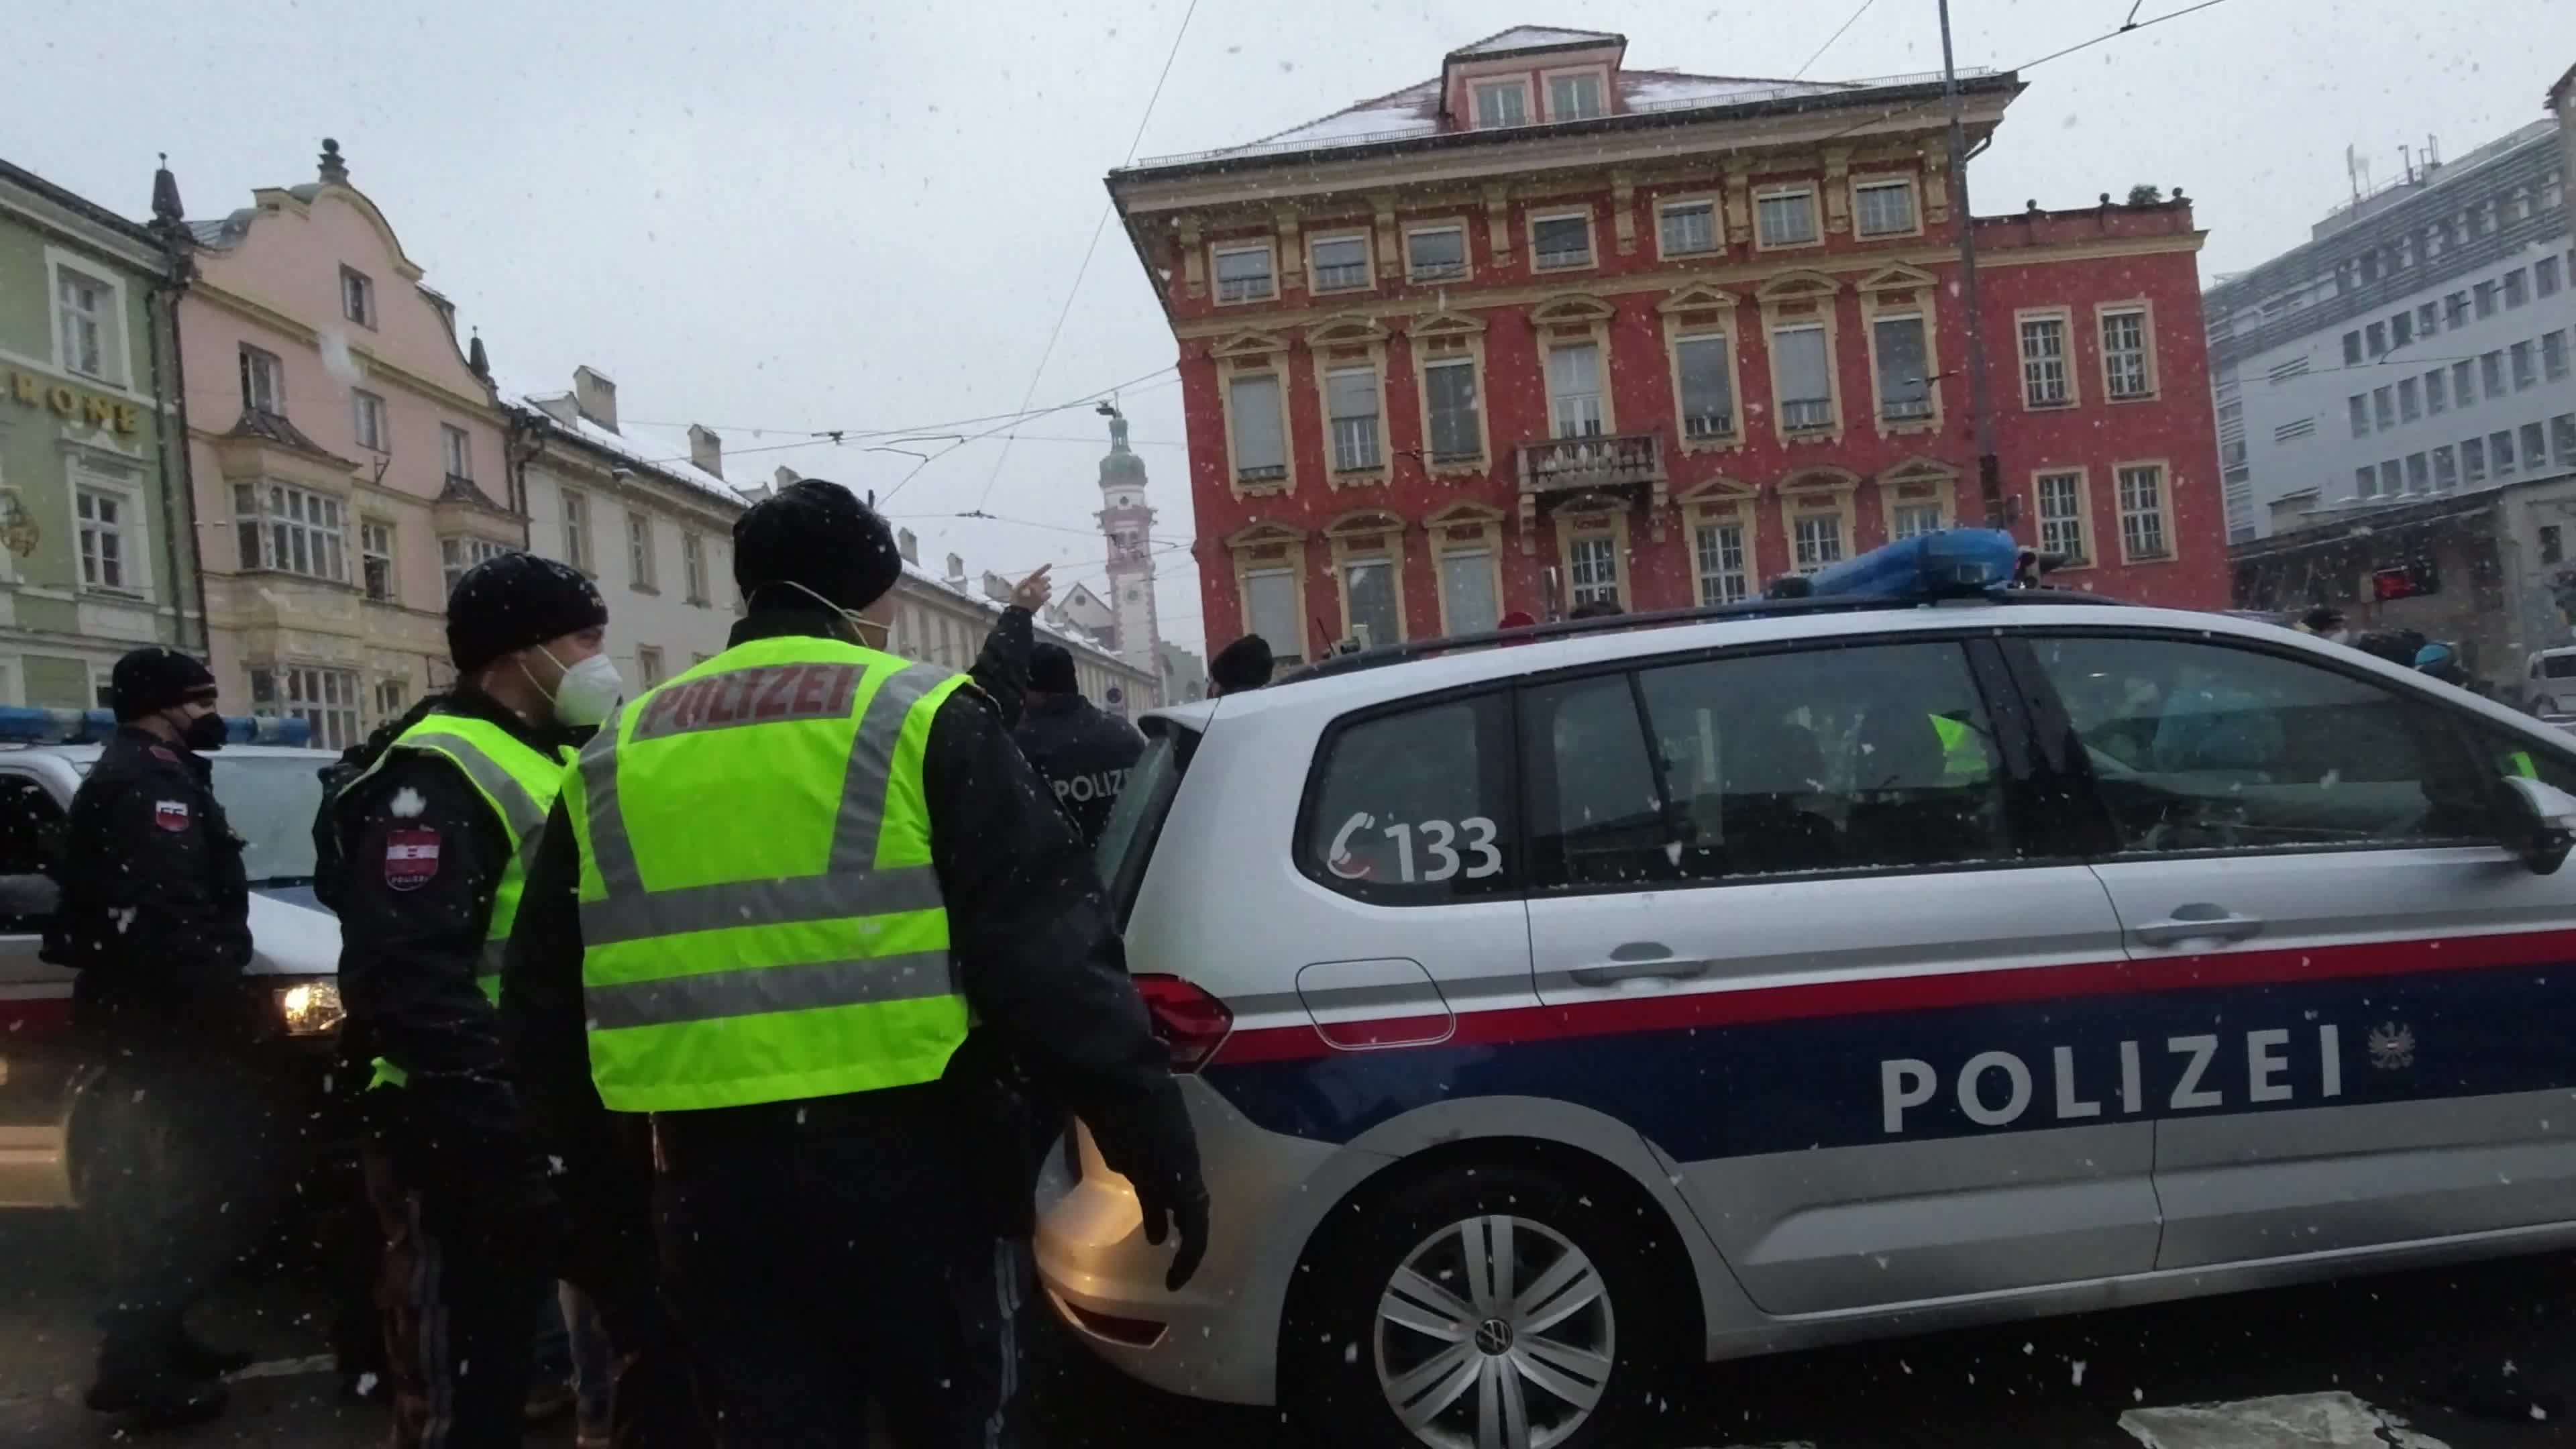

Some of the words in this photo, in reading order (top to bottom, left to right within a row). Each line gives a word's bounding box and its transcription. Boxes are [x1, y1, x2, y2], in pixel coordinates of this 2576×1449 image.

[640, 665, 854, 734] POLIZEI
[1384, 817, 1501, 882] 133
[1881, 1024, 2342, 1132] POLIZEI
